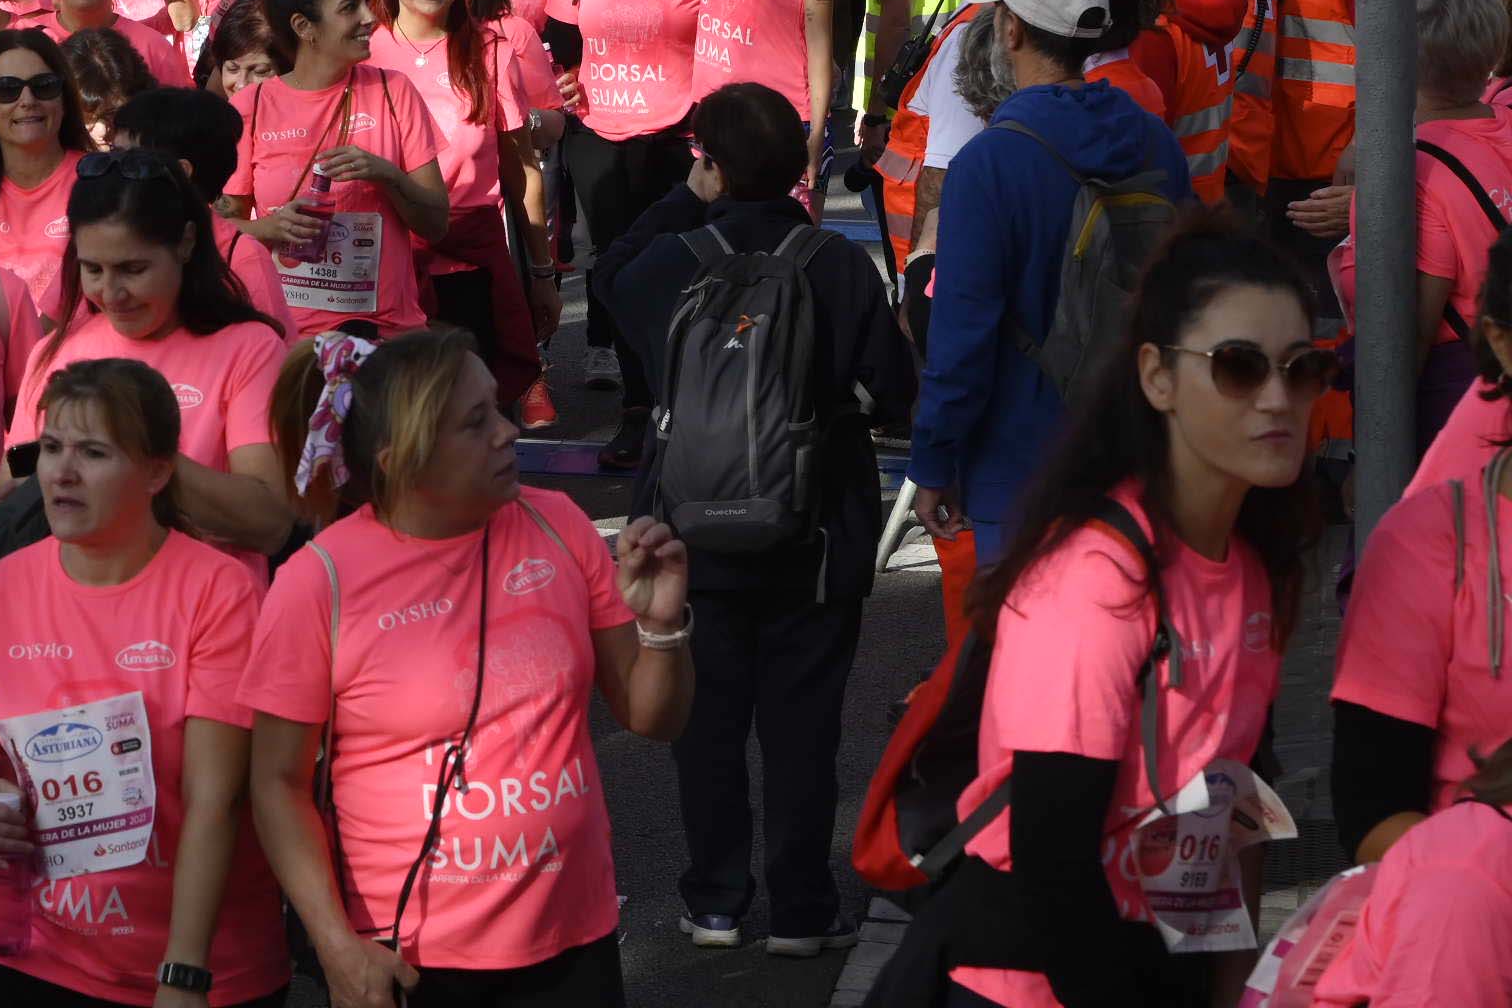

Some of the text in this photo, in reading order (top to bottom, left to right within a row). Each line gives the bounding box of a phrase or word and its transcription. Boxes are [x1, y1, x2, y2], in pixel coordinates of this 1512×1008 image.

[587, 38, 607, 56] TU
[591, 62, 666, 83] DORSAL
[592, 87, 646, 108] SUMA
[261, 127, 309, 142] OYSHO
[705, 506, 748, 517] Quechua
[378, 598, 455, 632] OYSHO
[8, 643, 73, 661] OYSHO
[31, 717, 136, 756] ASTURIANA SUMA
[40, 770, 104, 802] 016
[421, 758, 590, 821] DORSAL
[56, 803, 94, 822] 3937
[60, 828, 76, 840] DE
[77, 825, 91, 836] LA
[92, 819, 127, 833] MUJER
[427, 826, 560, 871] SUMA
[1180, 834, 1222, 861] 016
